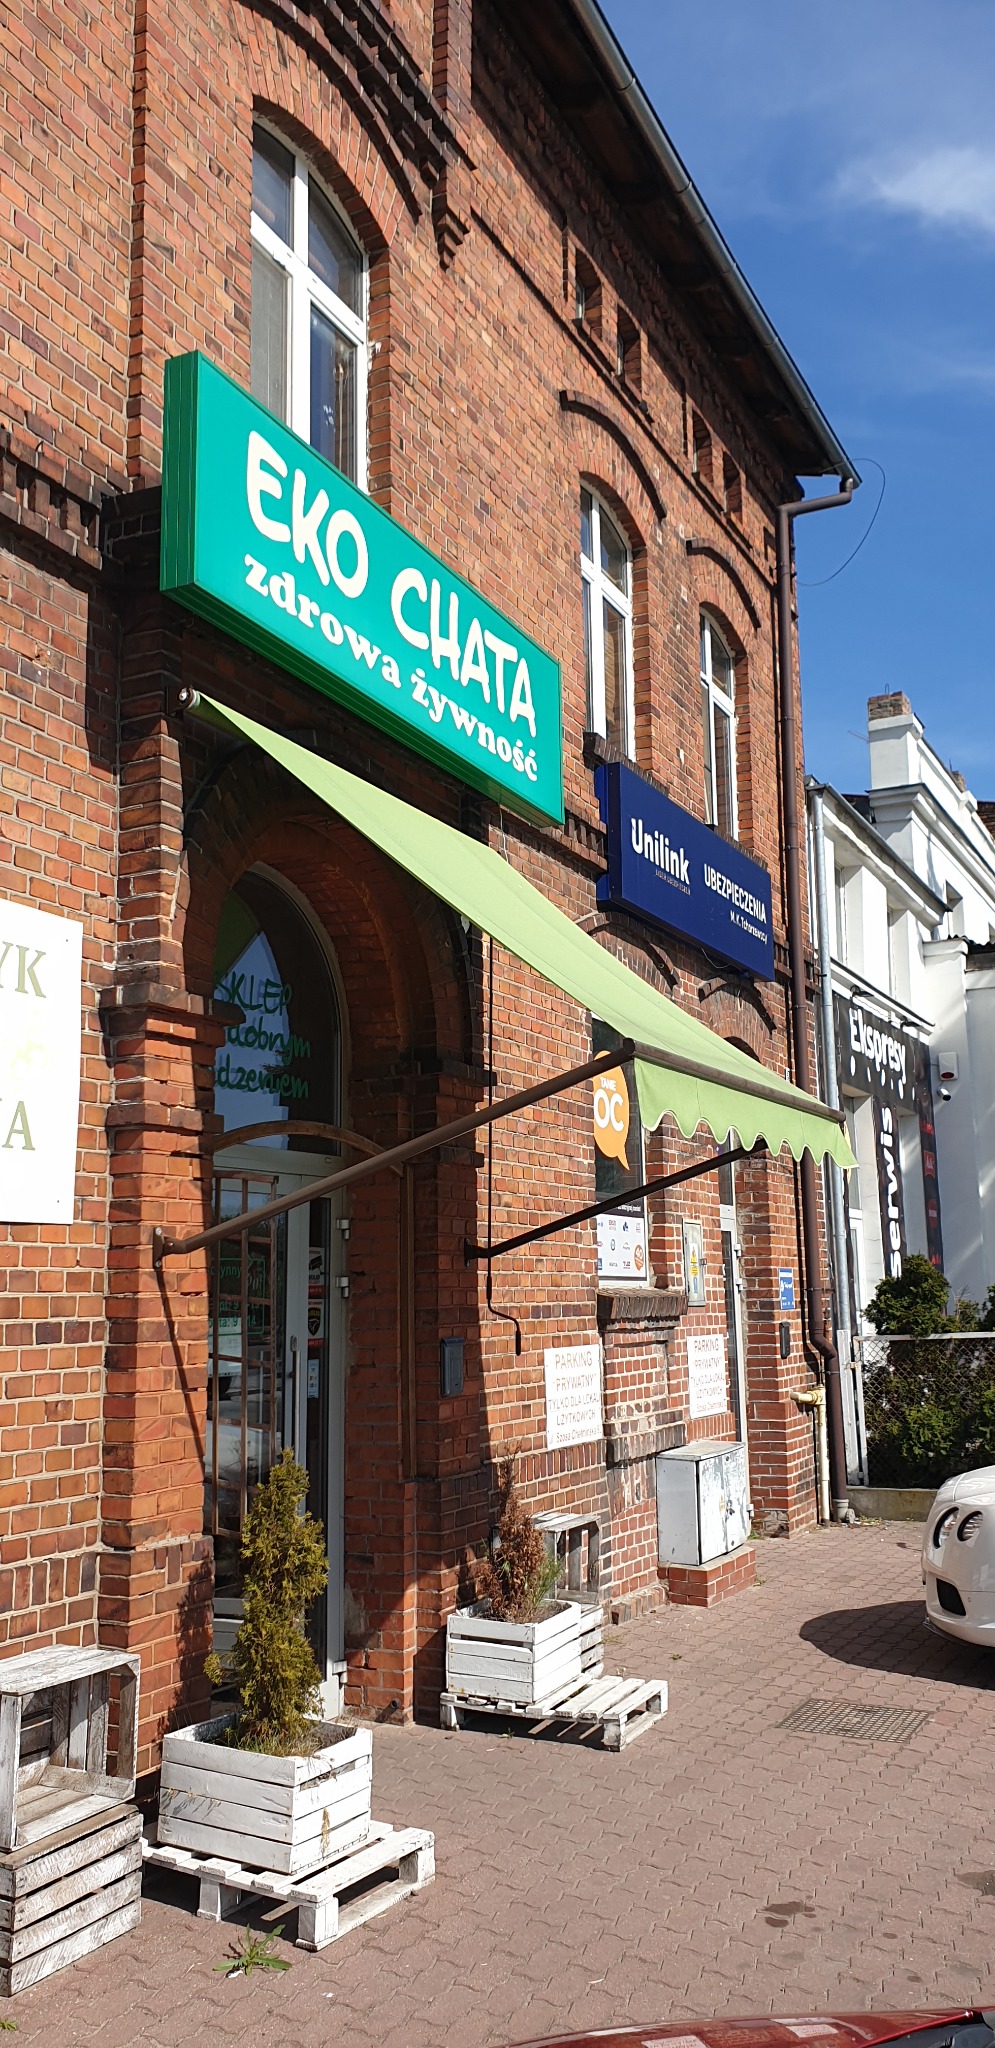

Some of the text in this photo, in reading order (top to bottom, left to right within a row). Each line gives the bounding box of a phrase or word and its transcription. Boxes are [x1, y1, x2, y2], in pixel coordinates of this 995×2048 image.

[246, 430, 537, 737] EKO CHATA
[244, 553, 538, 782] zdrowa żywność
[630, 817, 690, 885] Unilink
[703, 863, 767, 925] UBEZPIECZENIA
[849, 1007, 907, 1085] Ekspresy
[215, 1053, 309, 1099] dzeniem
[599, 1076, 617, 1092] TANIE
[593, 1088, 625, 1132] OC
[881, 1107, 902, 1279] serwis
[555, 1350, 593, 1370] PARKING
[694, 1337, 720, 1353] PARKING
[548, 1396, 569, 1410] TYLKO
[570, 1394, 582, 1407] DLA
